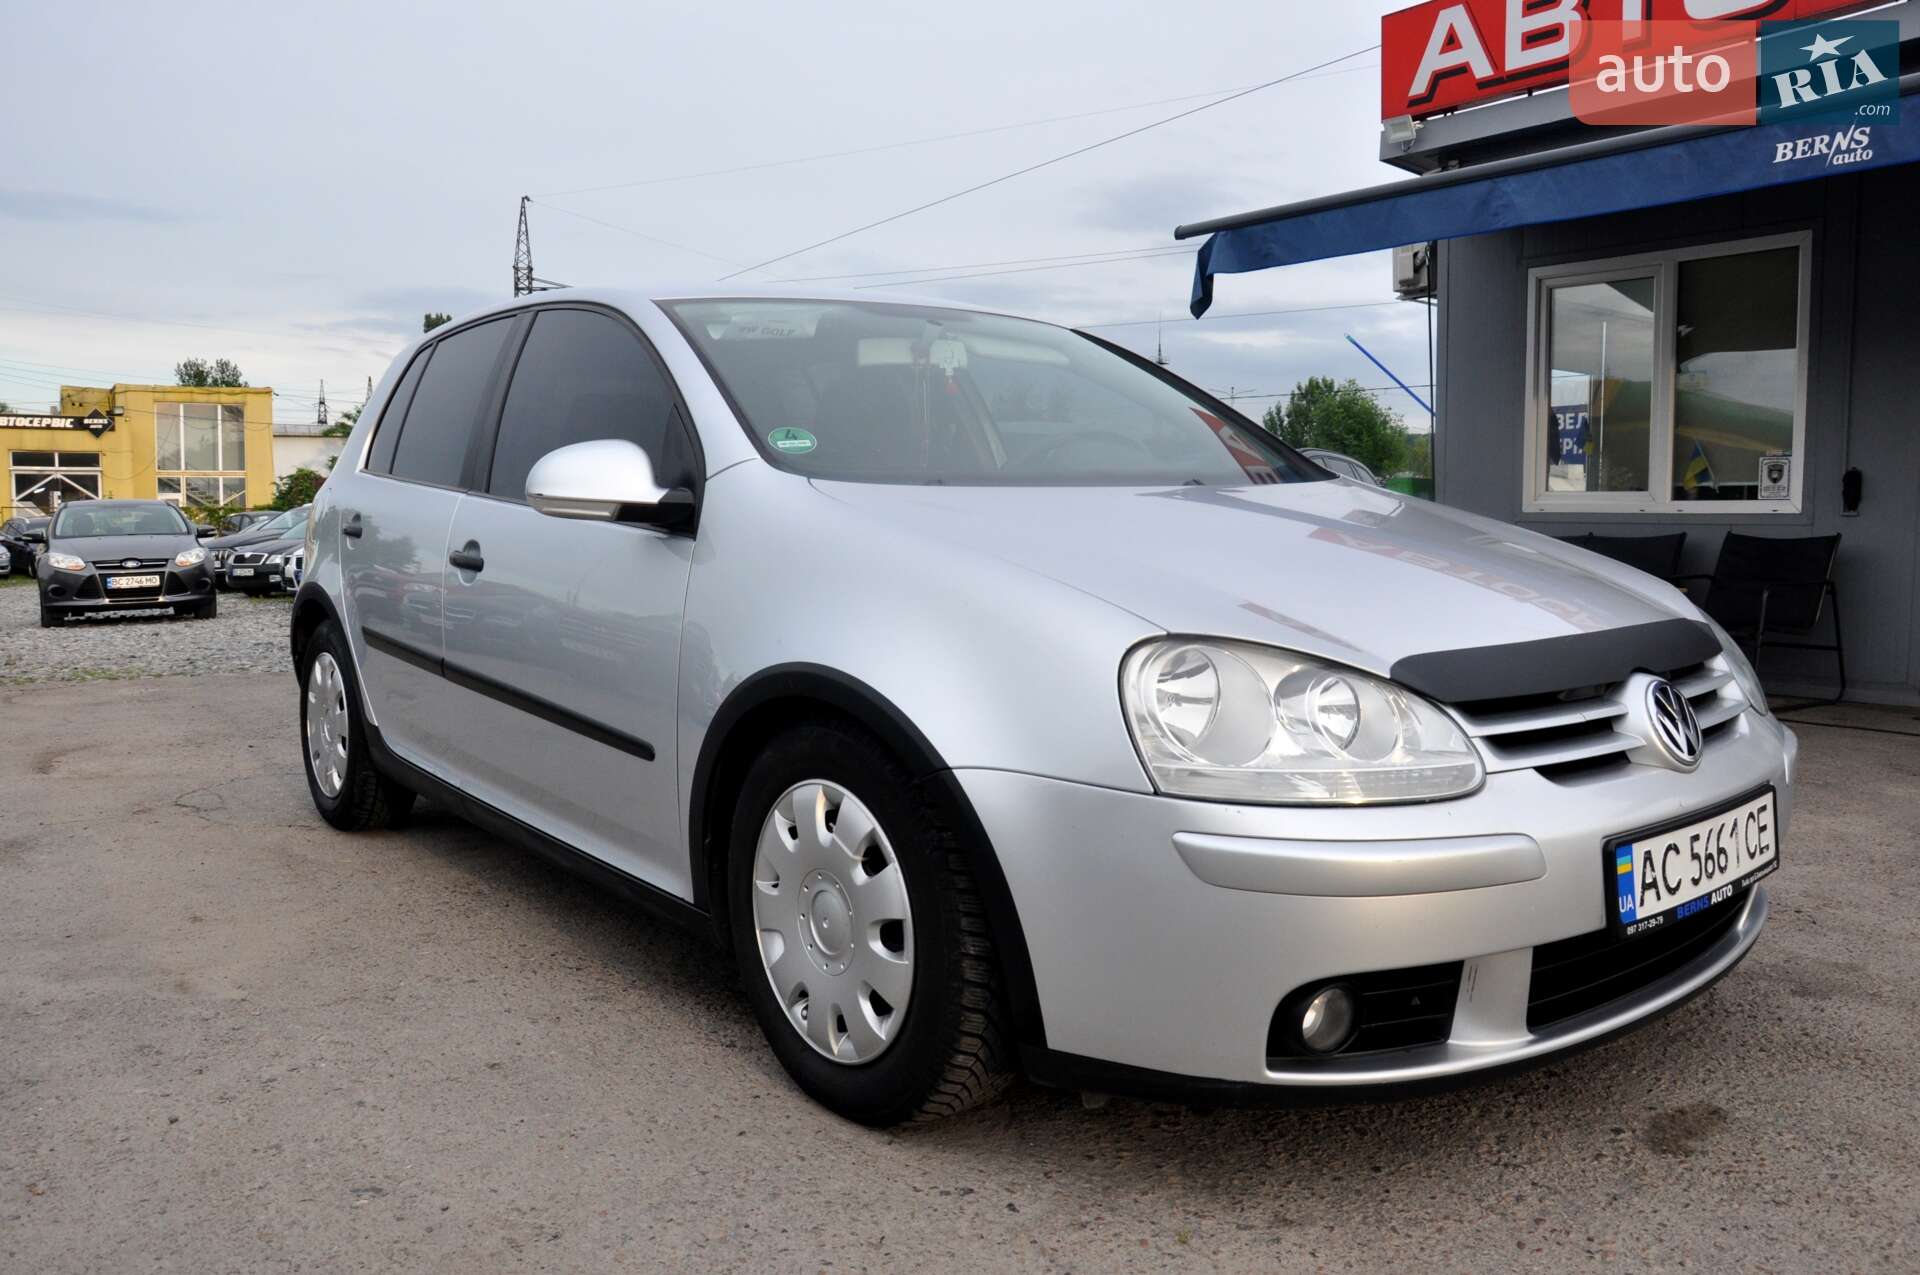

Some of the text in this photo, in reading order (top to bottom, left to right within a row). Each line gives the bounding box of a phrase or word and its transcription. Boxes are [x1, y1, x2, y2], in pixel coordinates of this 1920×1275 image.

[1773, 124, 1871, 167] BERNS
[1832, 148, 1873, 165] auto
[111, 578, 124, 586] BC
[126, 577, 144, 586] 2746
[1639, 843, 1682, 907] AC
[1689, 817, 1740, 886] 5661
[1745, 804, 1770, 860] CE
[1618, 894, 1635, 913] UA
[1676, 884, 1733, 919] BERNS AUTO
